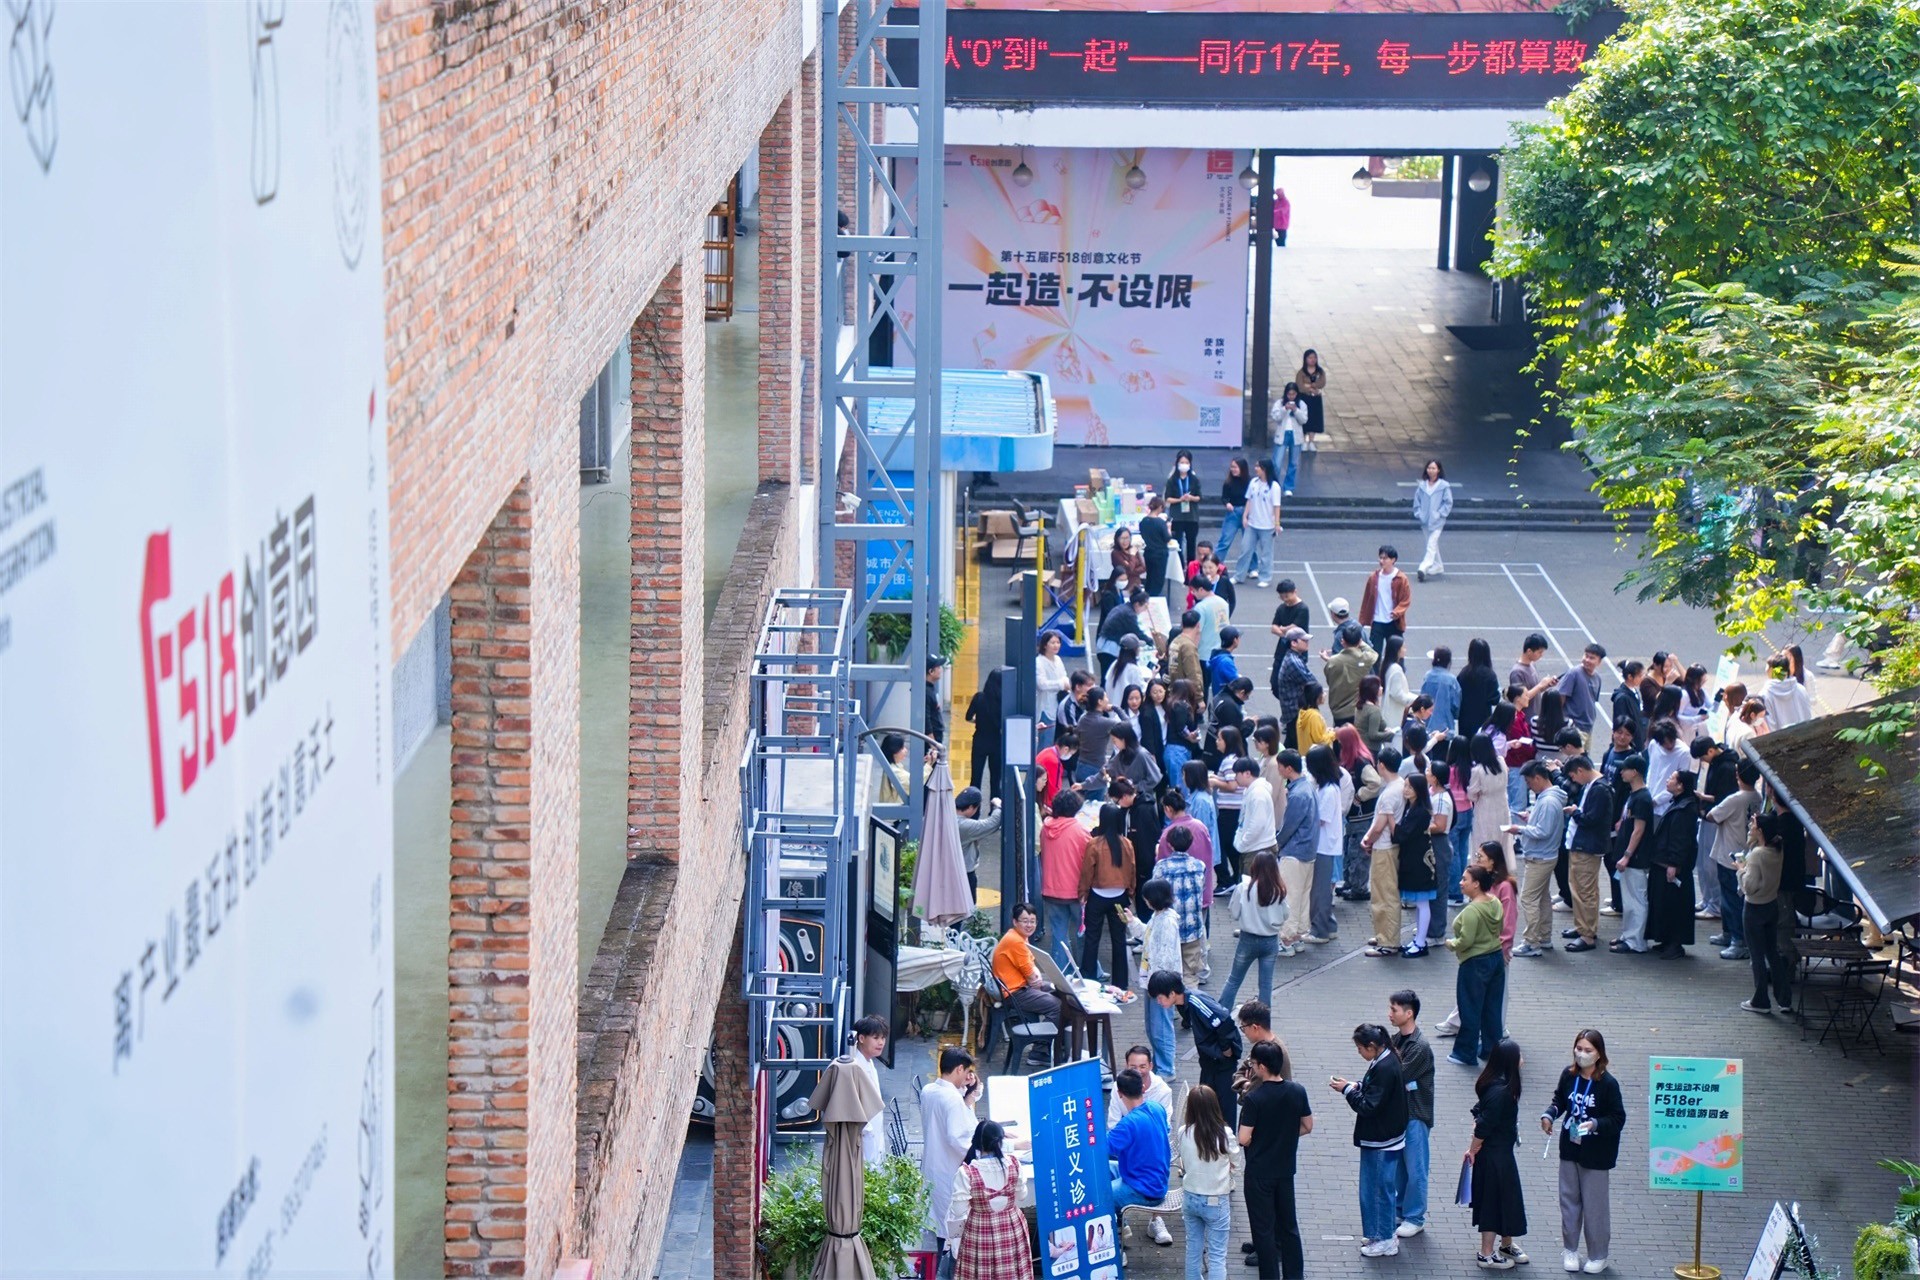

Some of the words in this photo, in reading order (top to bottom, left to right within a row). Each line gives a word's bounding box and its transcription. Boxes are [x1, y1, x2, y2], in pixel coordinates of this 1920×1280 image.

[1001, 251, 1142, 265] 第十五届F518创意文化节
[948, 271, 1193, 309] 一起造·不设限
[139, 493, 318, 830] F518创意园
[1656, 1082, 1720, 1092] 养生运动不设限
[1655, 1094, 1702, 1106] F518er
[1655, 1108, 1729, 1119] 一起创造游园会
[1063, 1096, 1085, 1204] 中医义诊
